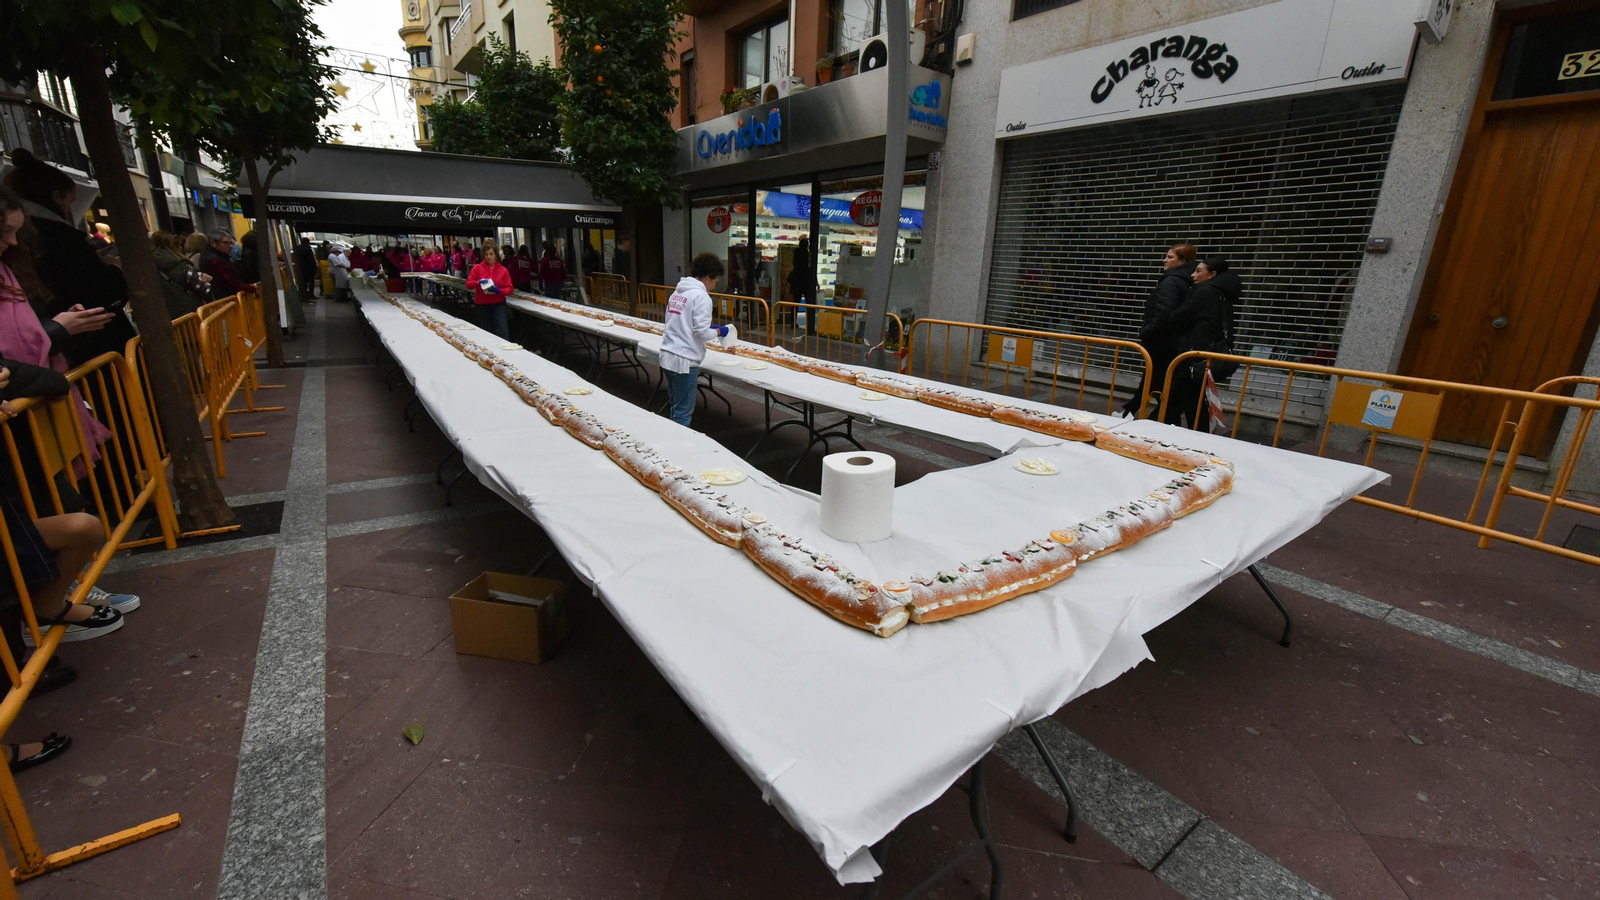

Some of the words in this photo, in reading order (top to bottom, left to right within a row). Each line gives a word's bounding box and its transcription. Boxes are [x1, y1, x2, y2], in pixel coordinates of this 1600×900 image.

[1341, 61, 1386, 80] Outlet
[1561, 50, 1600, 78] 32
[1005, 120, 1027, 133] Outlet
[855, 194, 882, 205] REGAL
[404, 206, 438, 221] Tasca
[463, 208, 505, 222] Violinista
[574, 214, 614, 226] Cruzcampo
[1370, 401, 1397, 411] PLAYAS
